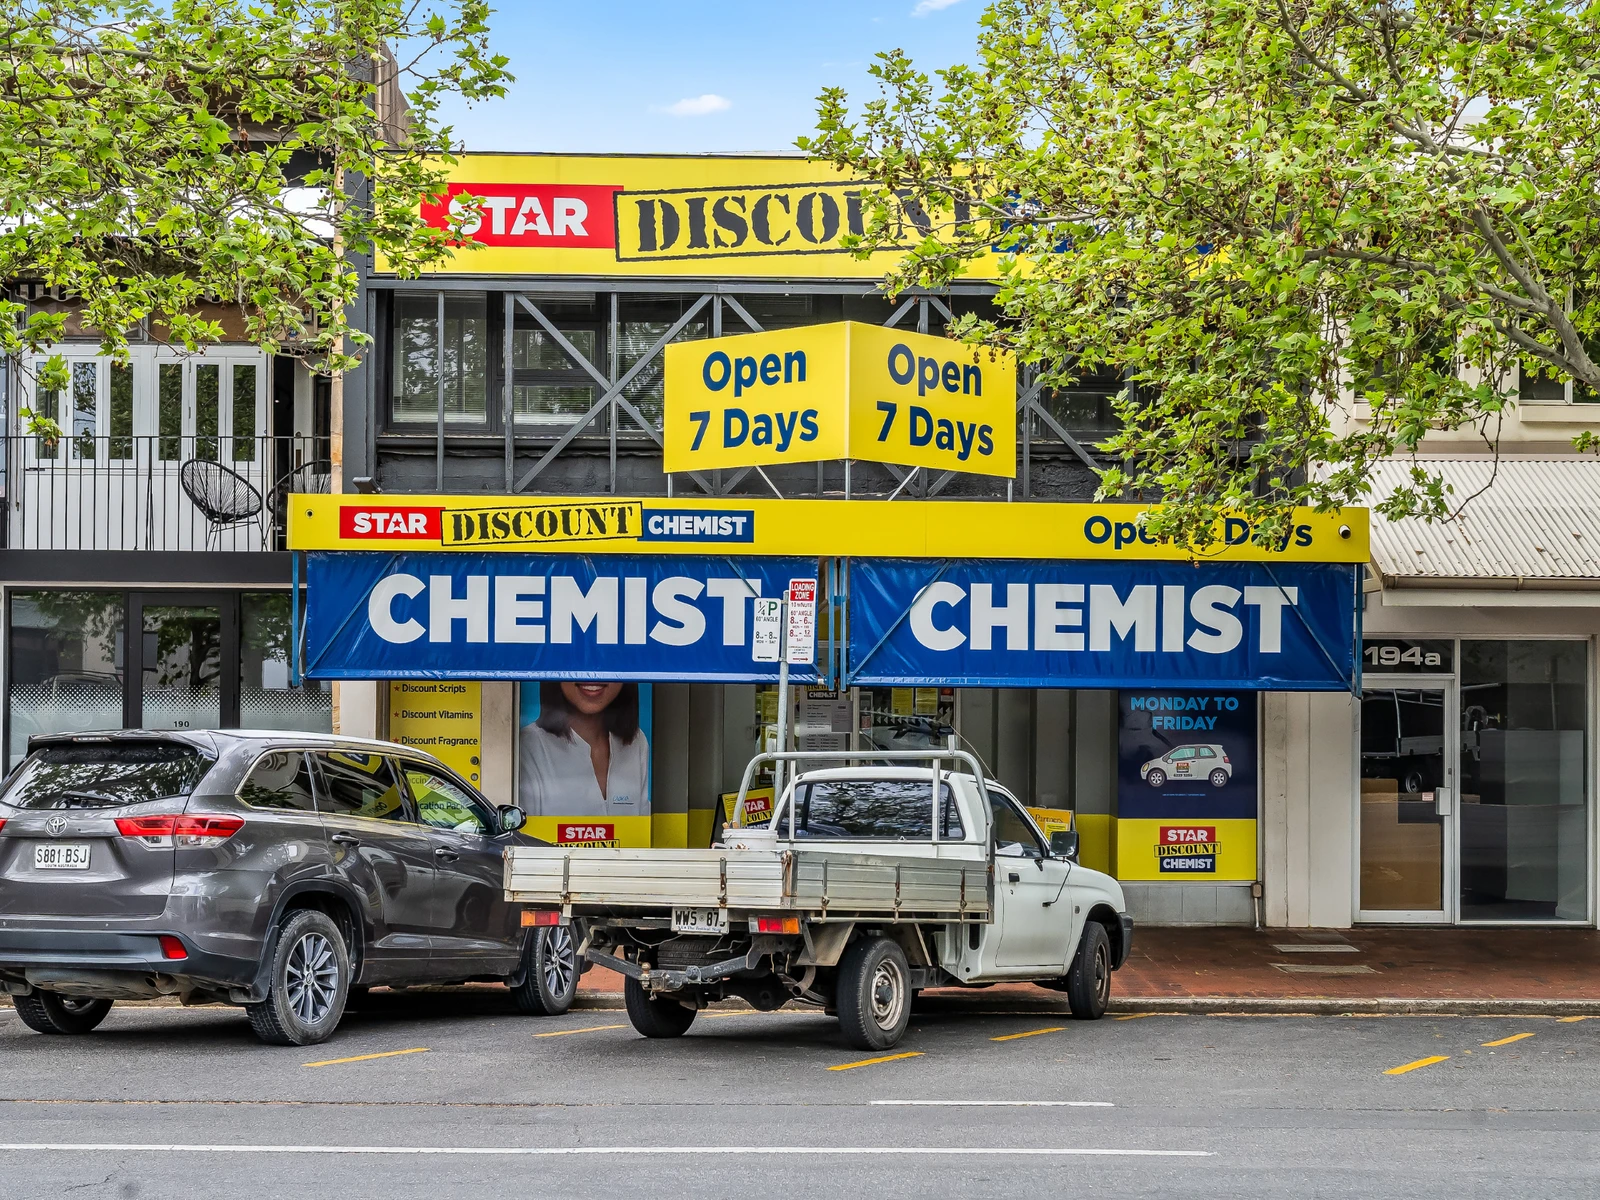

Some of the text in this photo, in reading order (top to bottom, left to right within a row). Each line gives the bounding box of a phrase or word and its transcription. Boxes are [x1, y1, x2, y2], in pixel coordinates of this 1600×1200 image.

[447, 195, 588, 236] STAR
[703, 350, 807, 398] Open
[887, 343, 982, 397] Open
[690, 408, 819, 453] 7 Days
[876, 401, 994, 461] 7 Days
[353, 506, 747, 542] STAR DISCOUNT CHEMIST
[791, 583, 815, 591] LOADING
[795, 591, 810, 600] ZONE
[368, 573, 762, 647] CHEMIST
[768, 601, 778, 616] P
[909, 581, 1298, 654] CHEMIST
[1364, 646, 1441, 666] 194a
[402, 684, 466, 694] Discount Scripts
[1130, 697, 1239, 711] MONDAY TO
[402, 710, 473, 719] Discount Vitamins
[1152, 716, 1218, 730] FRIDAY
[402, 736, 478, 746] Discount Fragrance
[565, 827, 606, 839] STAR
[1167, 829, 1208, 841] STAR
[1158, 843, 1218, 856] DISCOUNT
[1163, 858, 1212, 869] CHEMIST
[675, 910, 697, 926] WWS
